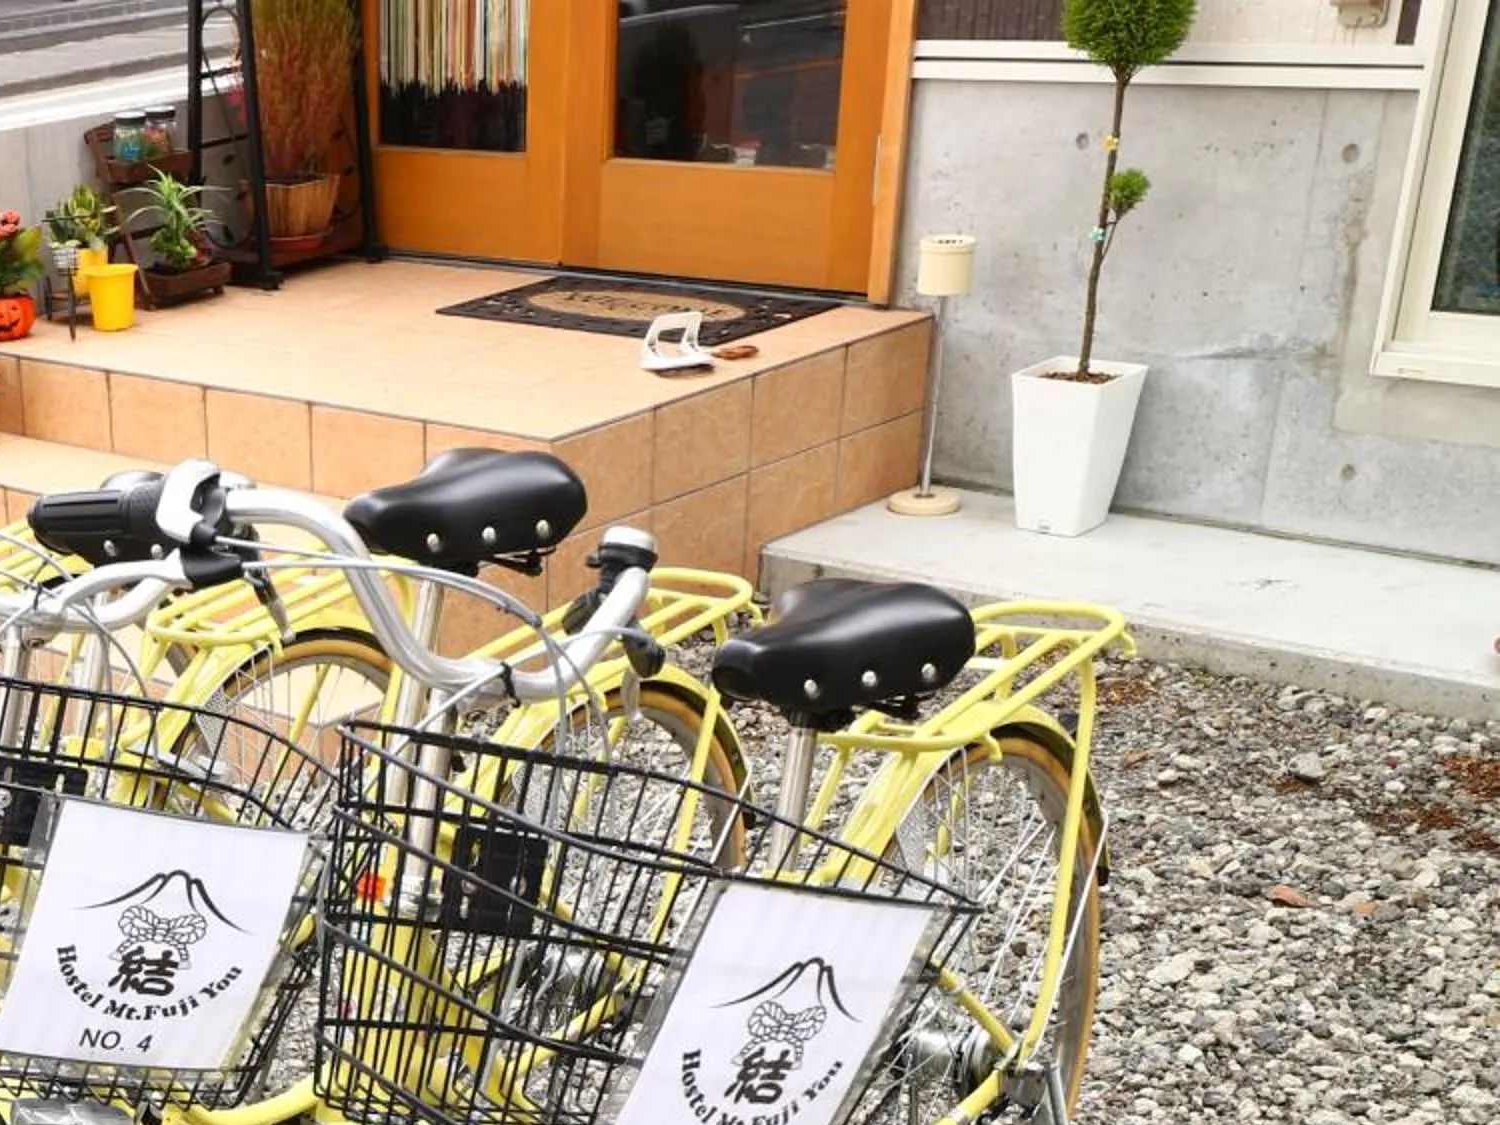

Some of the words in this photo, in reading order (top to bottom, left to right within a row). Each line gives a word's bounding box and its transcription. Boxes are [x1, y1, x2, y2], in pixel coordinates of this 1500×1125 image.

[56, 944, 105, 1008] Hostel
[200, 965, 243, 999] You
[79, 1028, 125, 1051] NO.
[136, 1034, 154, 1052] 4
[681, 1049, 718, 1124] Hostel
[803, 1060, 844, 1100] You
